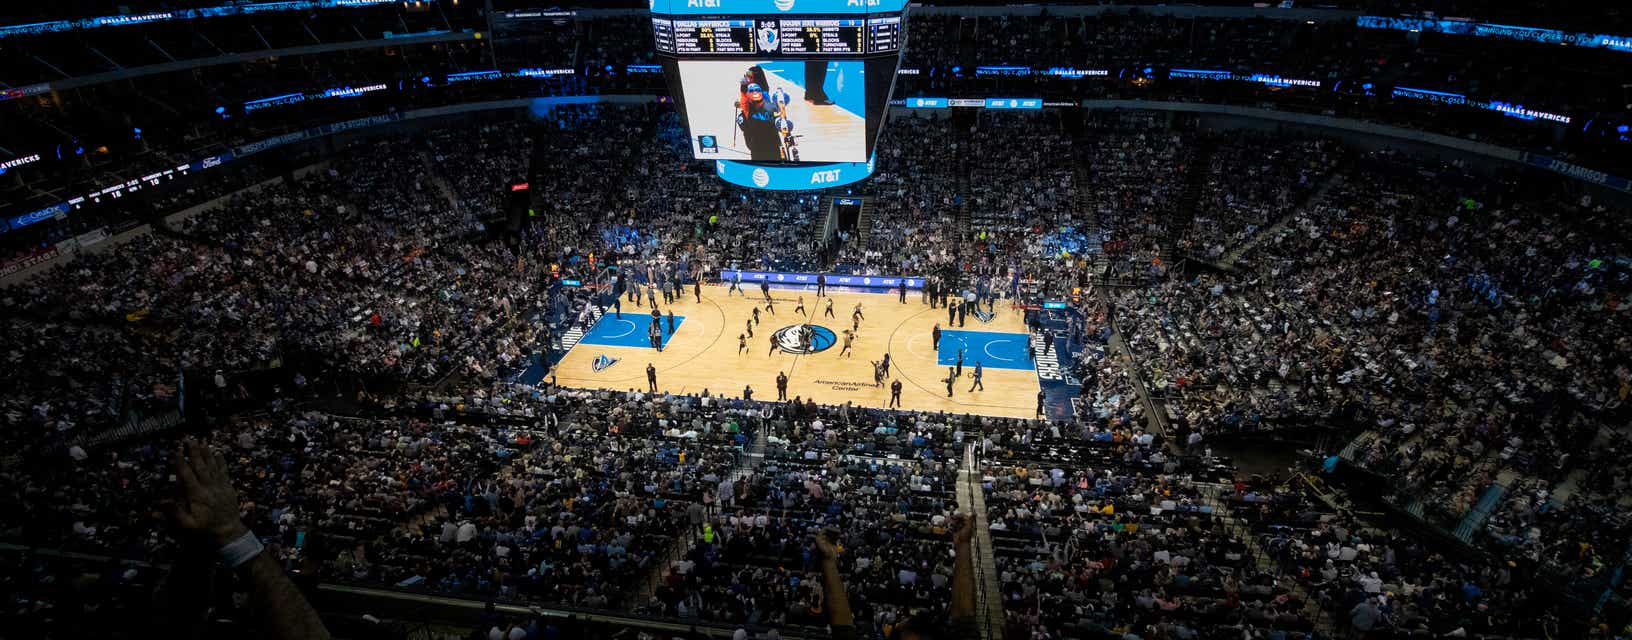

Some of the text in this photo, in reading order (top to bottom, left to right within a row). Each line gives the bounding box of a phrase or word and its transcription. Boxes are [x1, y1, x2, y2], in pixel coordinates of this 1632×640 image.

[131, 12, 173, 21] MAVERICKS
[1257, 76, 1321, 87] DALLAS MAVERICKS
[1496, 104, 1571, 124] DALLAS MAVERICKS
[811, 169, 841, 184] AT&T
